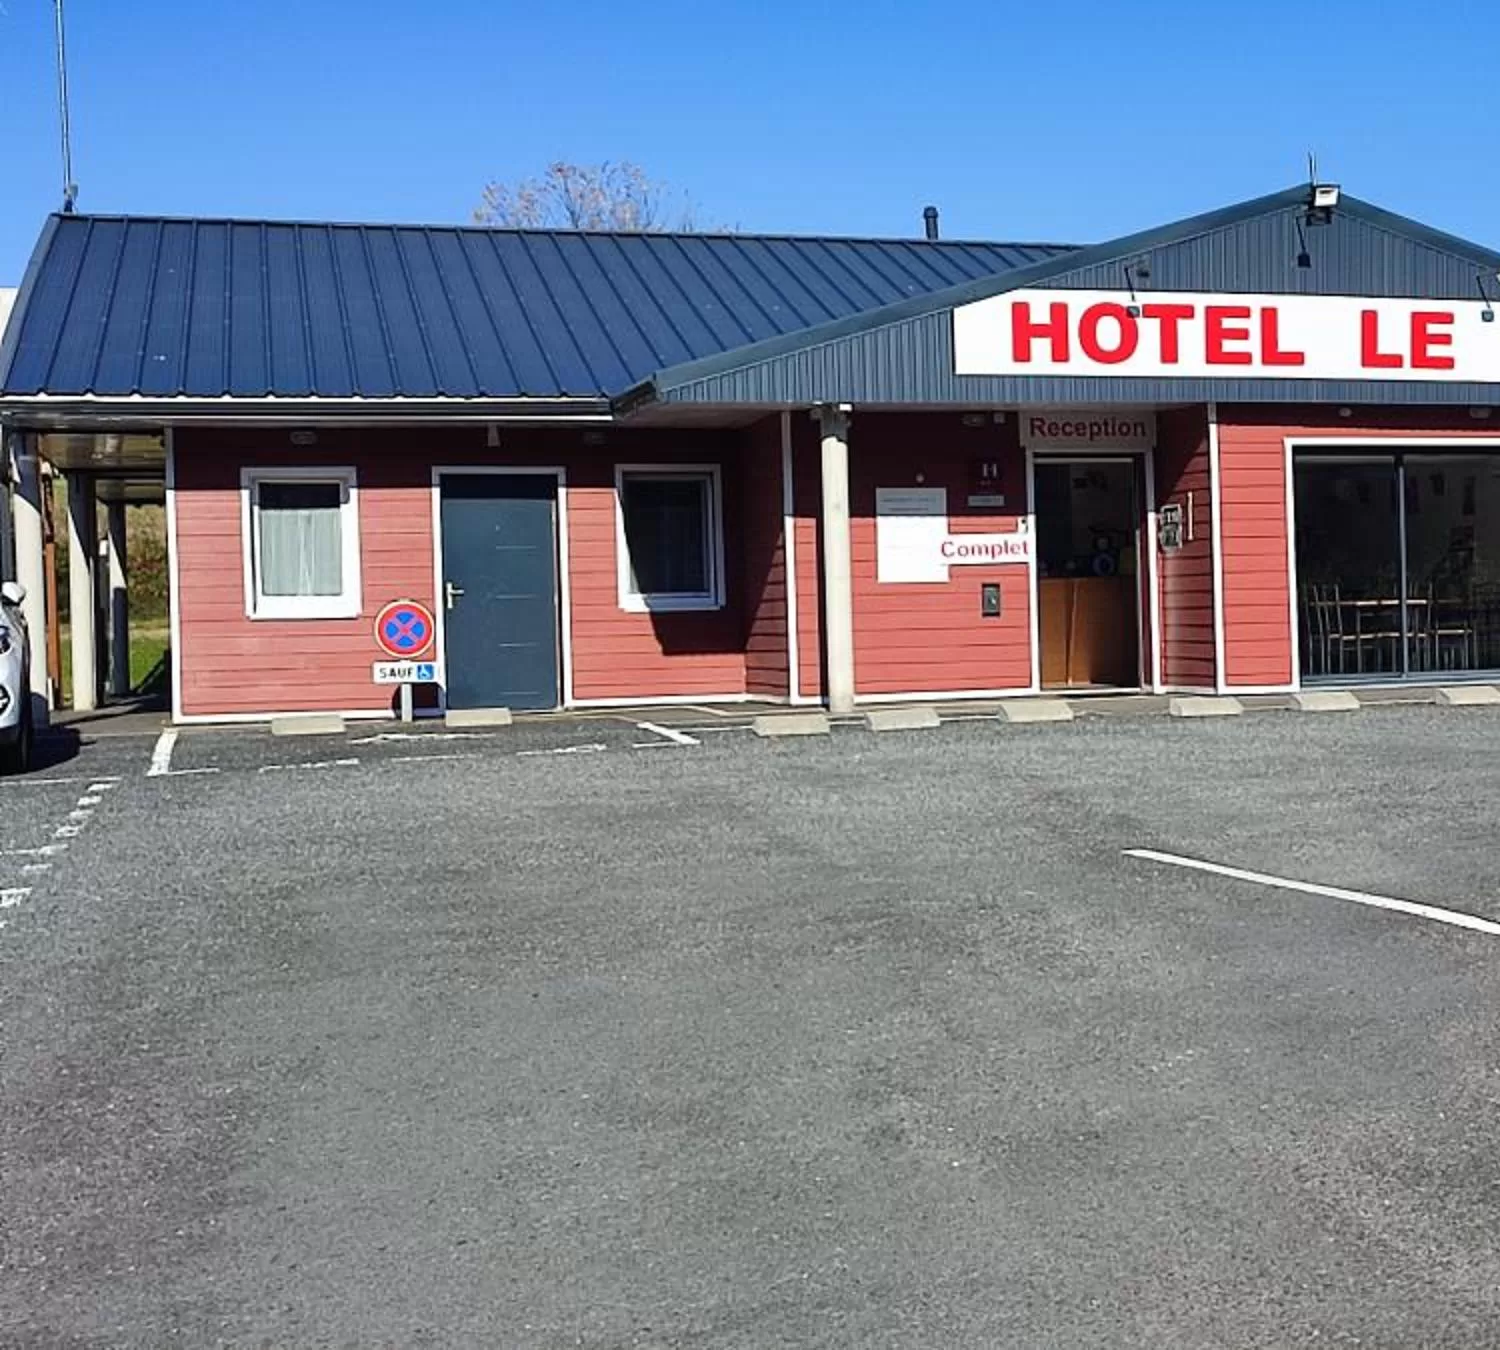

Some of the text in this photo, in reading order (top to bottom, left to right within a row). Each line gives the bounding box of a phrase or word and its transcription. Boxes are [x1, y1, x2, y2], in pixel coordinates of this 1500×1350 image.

[1011, 301, 1305, 367] HOTEL
[1361, 310, 1455, 370] LE
[1029, 417, 1146, 441] Reception
[940, 540, 1029, 559] Complet
[379, 667, 413, 679] SAUF
